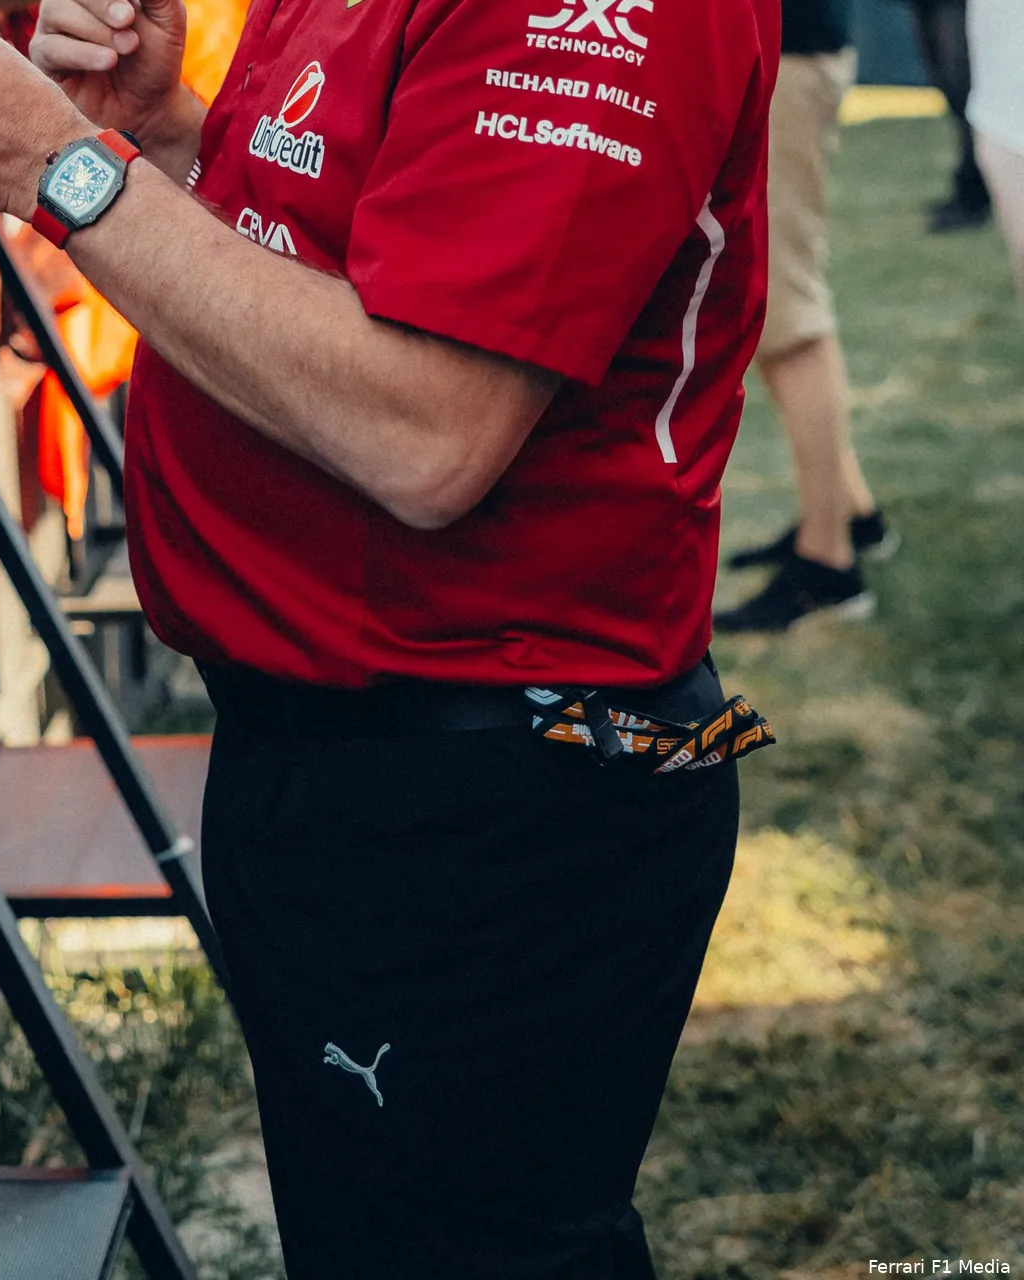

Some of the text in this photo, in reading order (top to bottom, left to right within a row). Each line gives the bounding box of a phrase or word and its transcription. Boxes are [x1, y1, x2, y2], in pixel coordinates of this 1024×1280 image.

[526, 33, 645, 67] TECHNOLOGY
[485, 68, 658, 119] RICHARD MILLE
[251, 117, 323, 175] UniCredit
[475, 110, 643, 167] HCLSoftware
